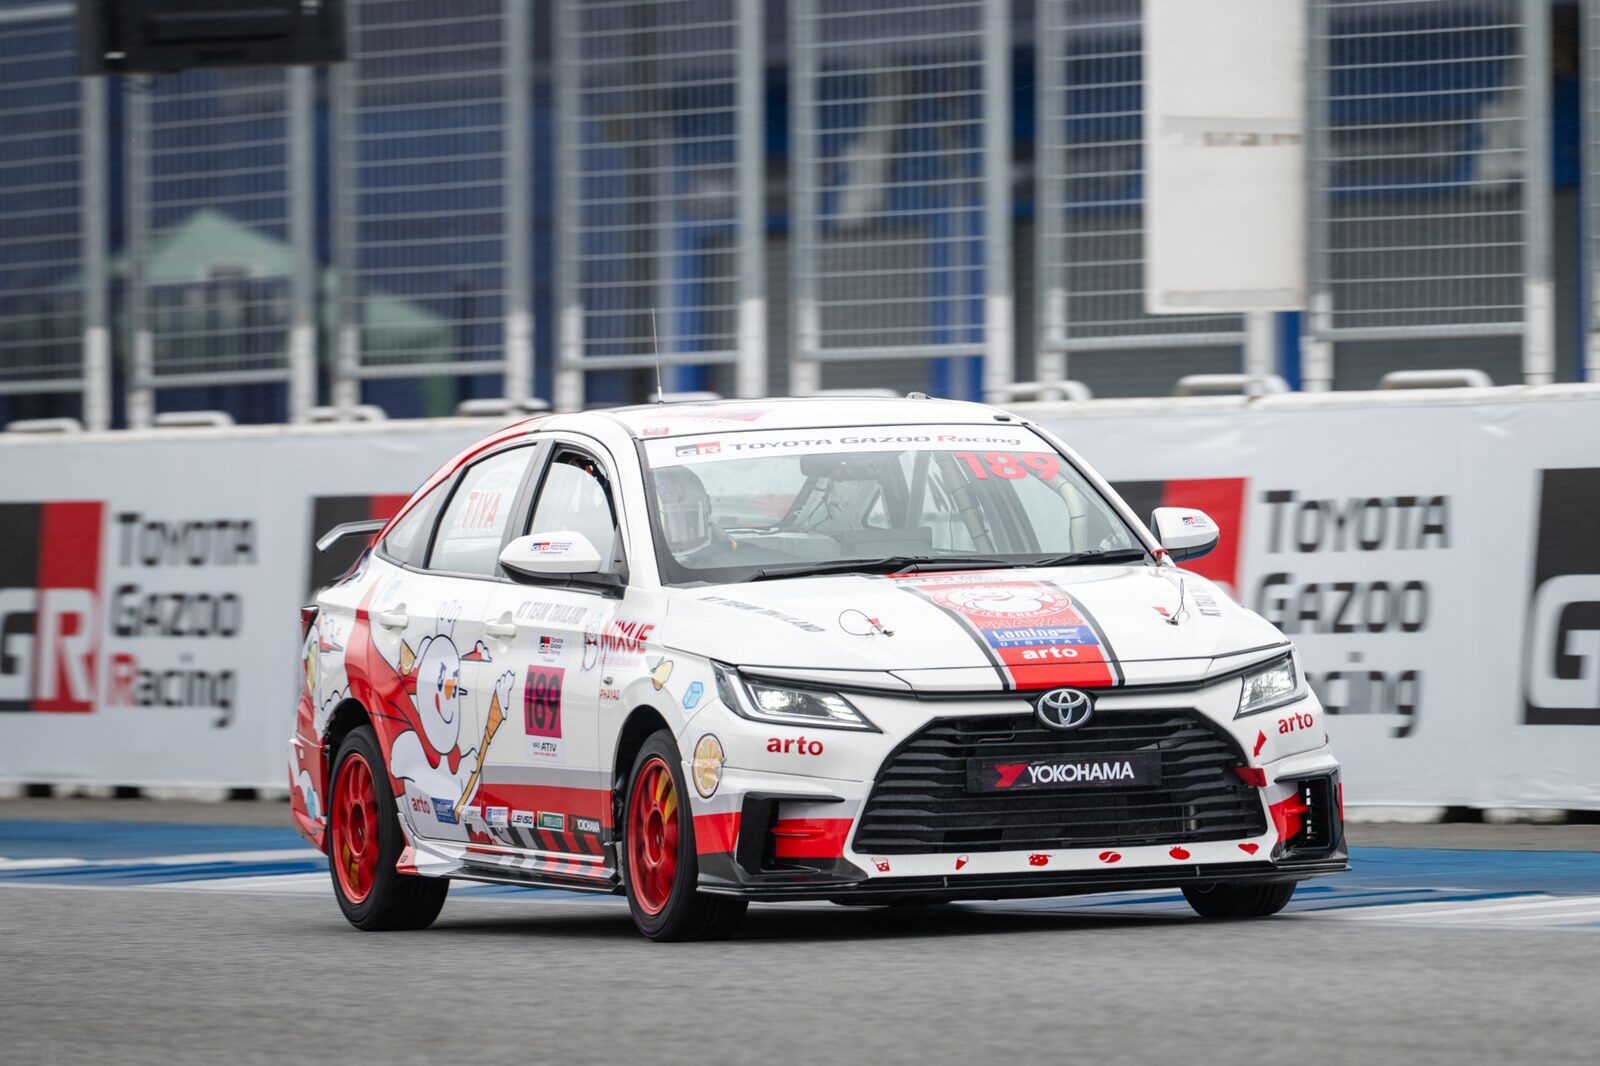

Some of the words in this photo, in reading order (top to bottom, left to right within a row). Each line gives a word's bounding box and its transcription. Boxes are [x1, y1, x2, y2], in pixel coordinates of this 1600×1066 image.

[730, 438, 832, 451] TOYOTA
[840, 436, 930, 444] GAZOO
[937, 435, 1020, 445] Racing
[954, 452, 1061, 480] 189
[462, 491, 501, 529] TIYA
[1261, 490, 1450, 554] TOYOTA
[115, 512, 258, 567] TOYOTA
[111, 584, 243, 637] GAZOO
[992, 629, 1059, 639] Lamina
[1000, 639, 1084, 647] DIGITAL
[1021, 647, 1078, 659] arto
[107, 652, 237, 729] Racing
[526, 671, 561, 731] 189
[1305, 651, 1421, 738] cing
[1277, 712, 1314, 734] arto
[767, 737, 823, 756] arto
[1028, 762, 1134, 784] YOKOHAMA
[412, 796, 431, 814] arto
